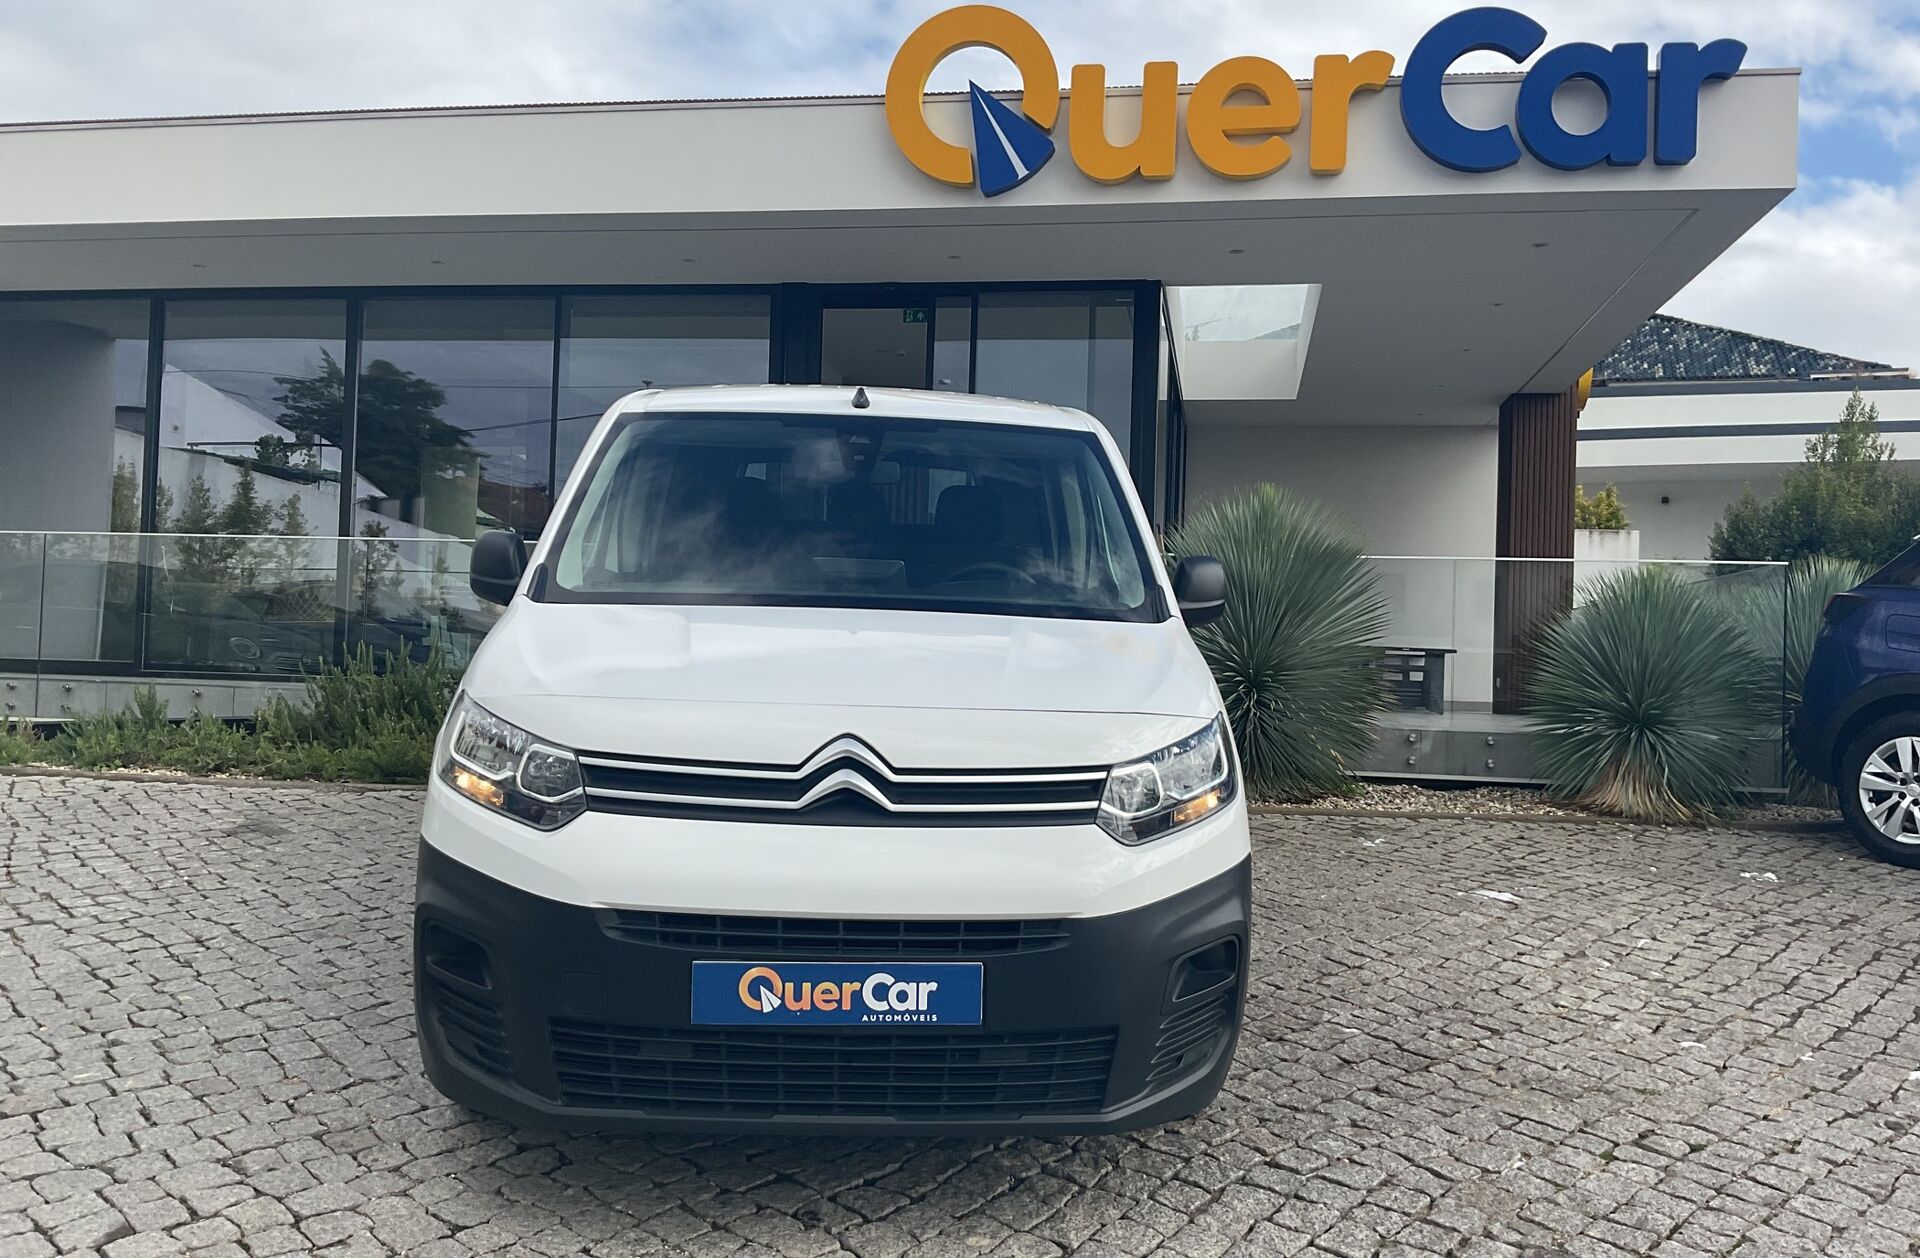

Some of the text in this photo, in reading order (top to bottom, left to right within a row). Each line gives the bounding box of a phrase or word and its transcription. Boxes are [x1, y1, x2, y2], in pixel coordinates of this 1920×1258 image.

[885, 5, 1747, 196] QuerCar
[738, 966, 938, 1013] QuerCar
[861, 1012, 938, 1022] AUTOMÓVEIS
